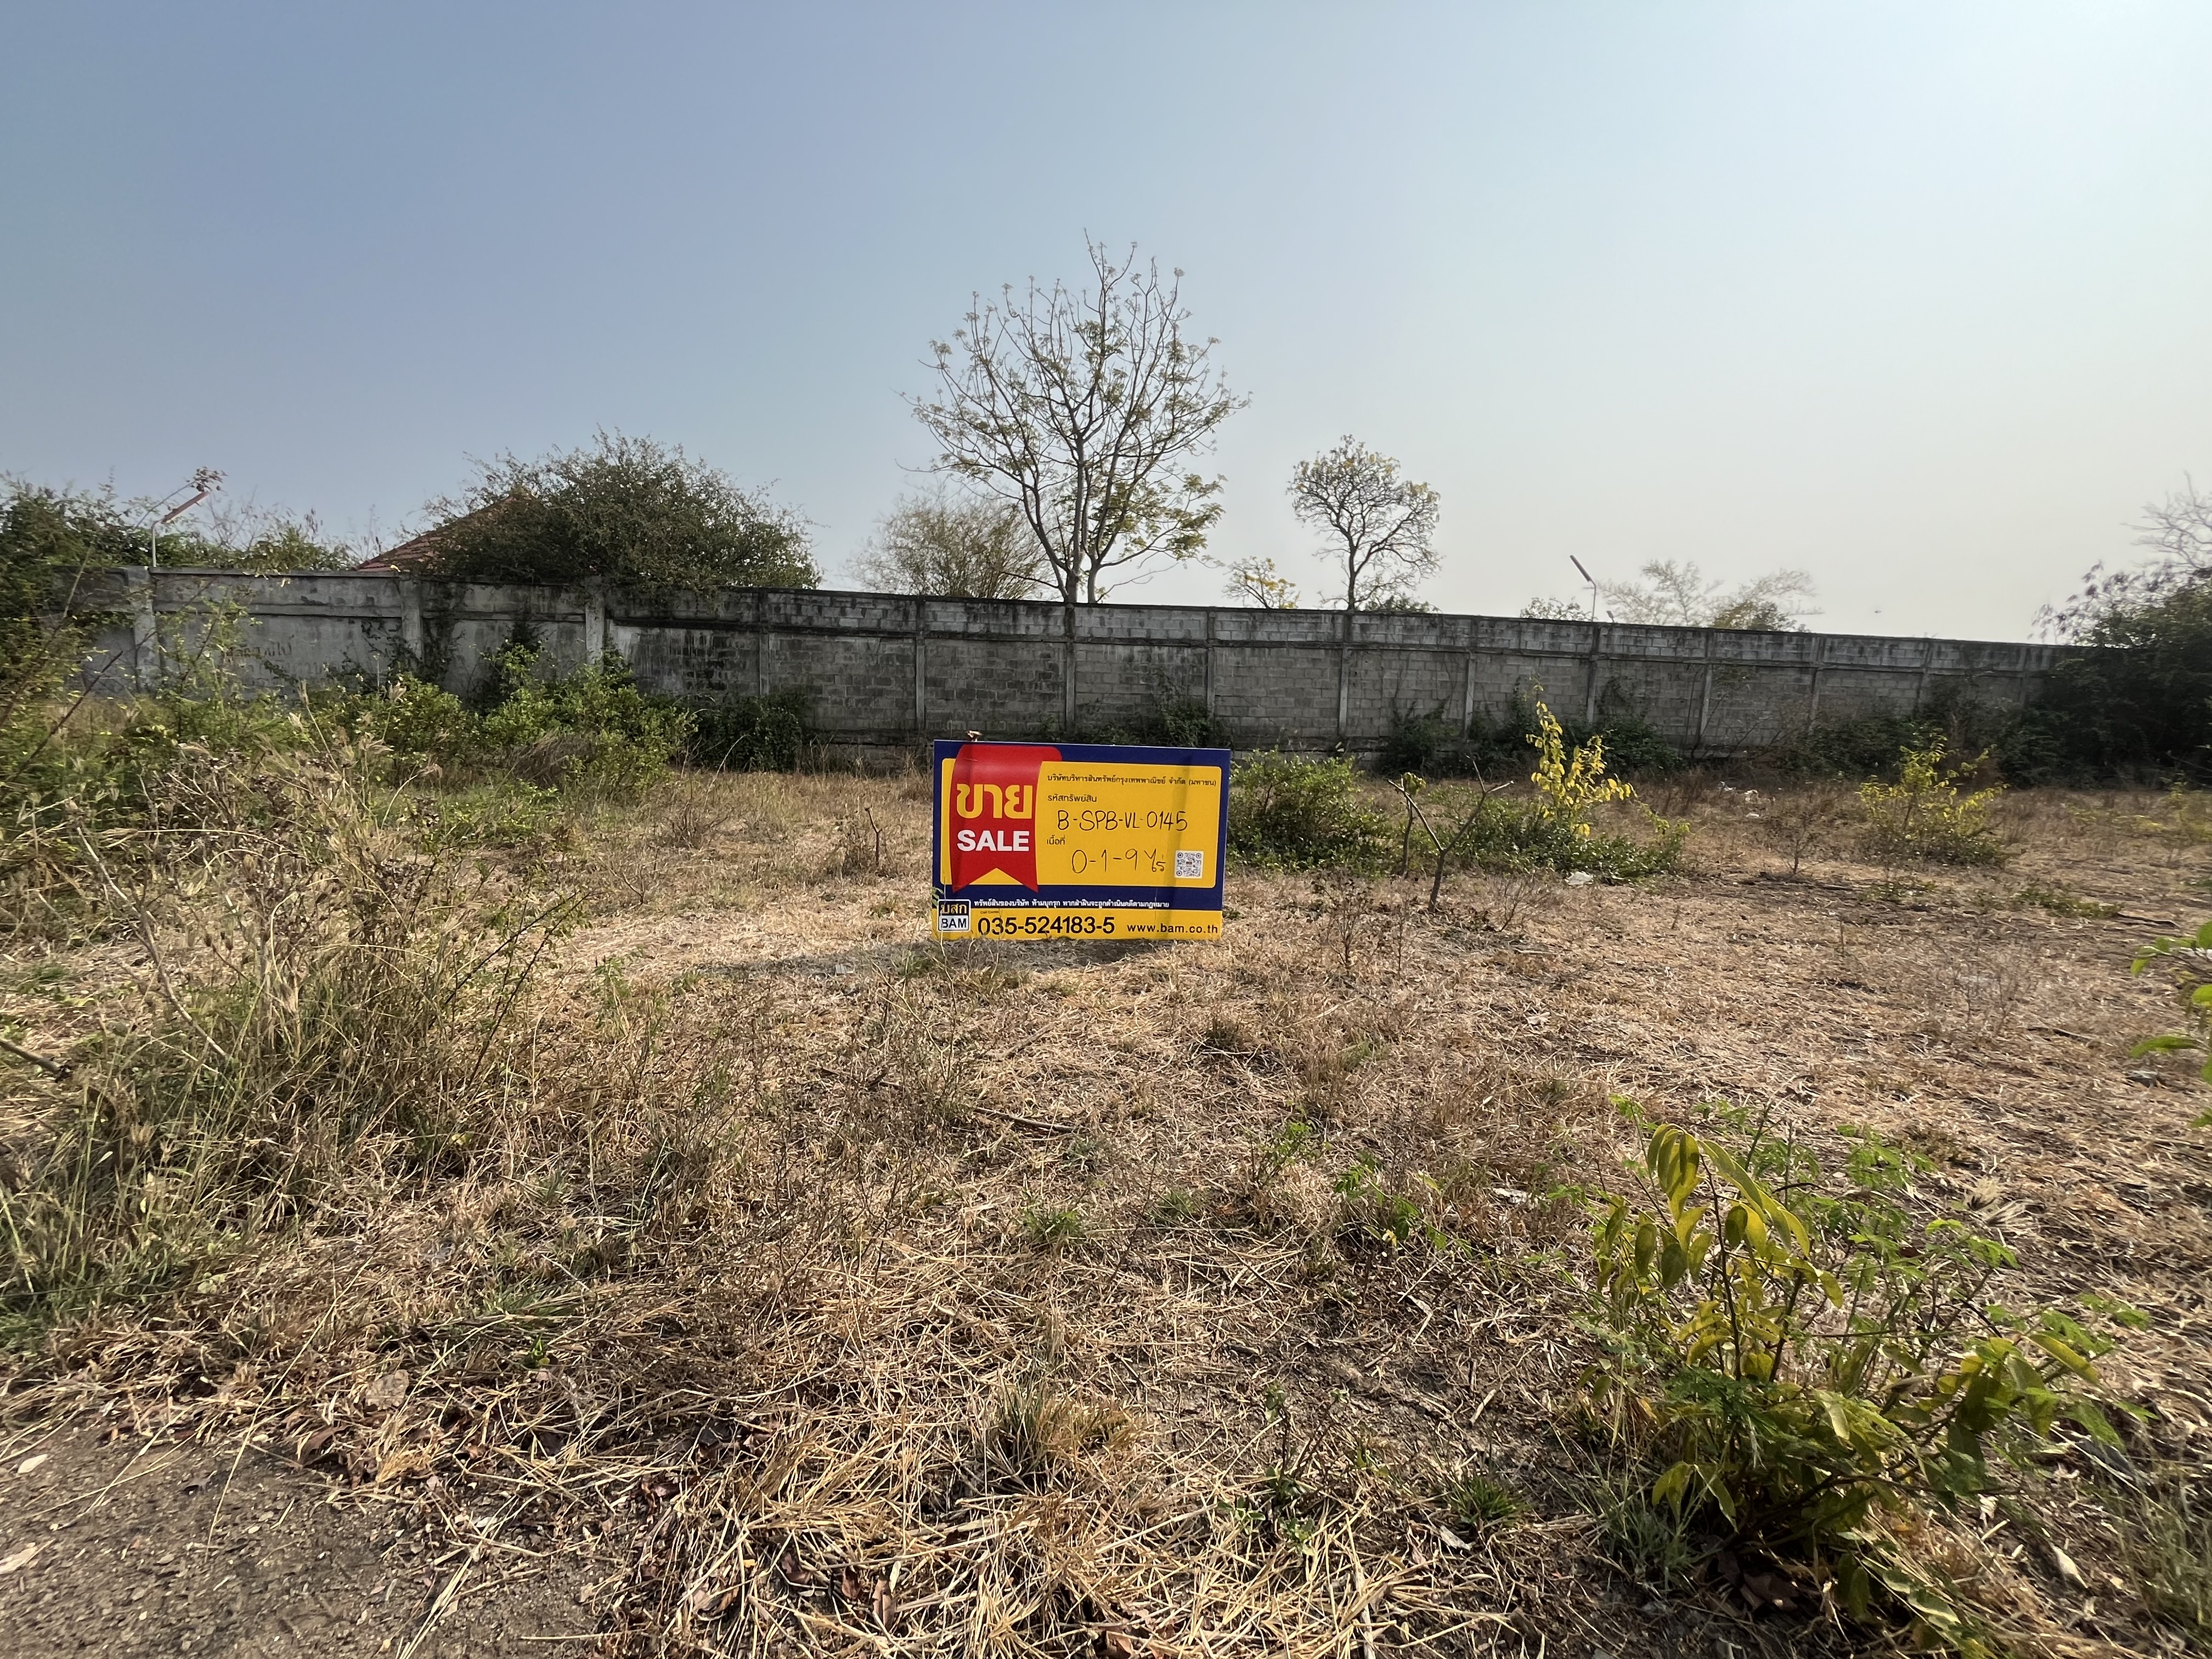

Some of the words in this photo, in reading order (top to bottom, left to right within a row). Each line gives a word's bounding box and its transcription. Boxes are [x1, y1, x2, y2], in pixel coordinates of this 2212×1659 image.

[1169, 777, 1186, 786] จำกัด
[956, 783, 1032, 819] ขาย
[1047, 793, 1097, 803] รหัสทรัพย์สิน
[957, 830, 1030, 852] SALE
[1046, 835, 1066, 845] เนื้อที่
[941, 918, 967, 928] BAM
[978, 916, 1115, 935] 035-524183-5
[1127, 923, 1218, 934] www.bam.co.th
